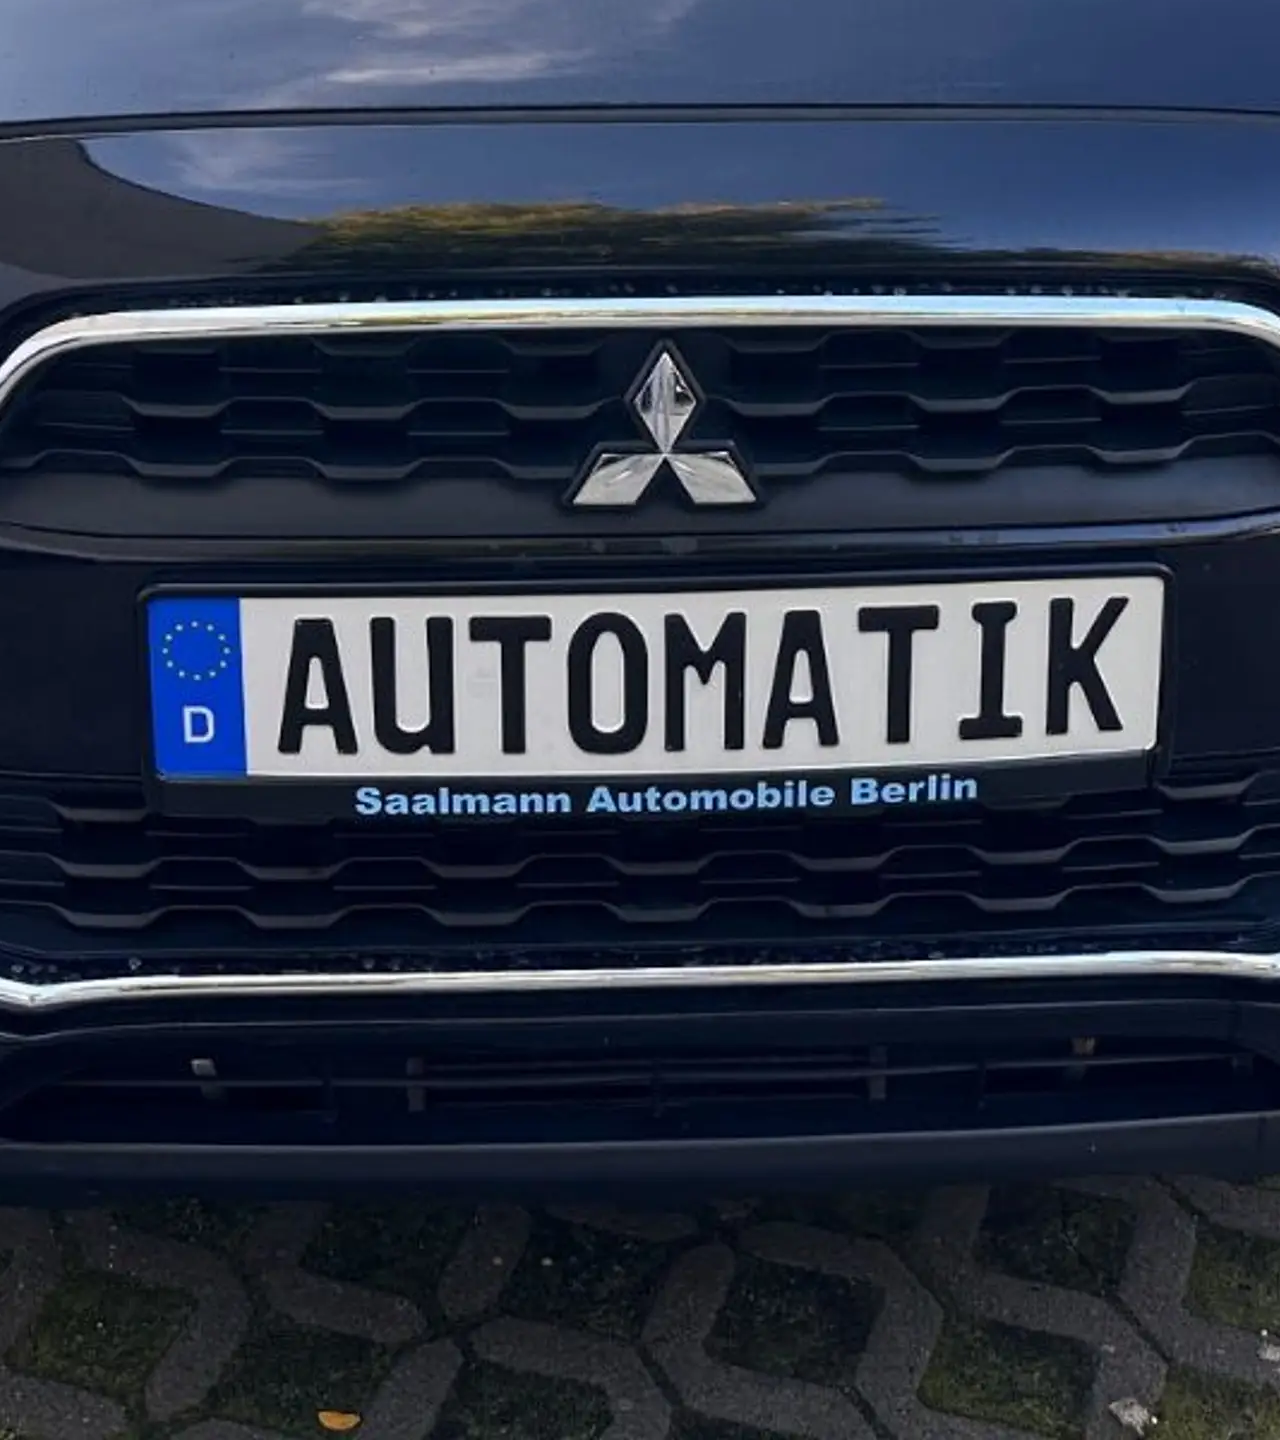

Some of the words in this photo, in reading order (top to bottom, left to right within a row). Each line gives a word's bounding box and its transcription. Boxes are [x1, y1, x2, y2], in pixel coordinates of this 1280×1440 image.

[277, 596, 1130, 756] AUTOMATIK
[182, 705, 215, 743] D
[354, 786, 572, 816] Saalmann
[585, 779, 836, 814] Automobile
[850, 773, 978, 806] Berlin
